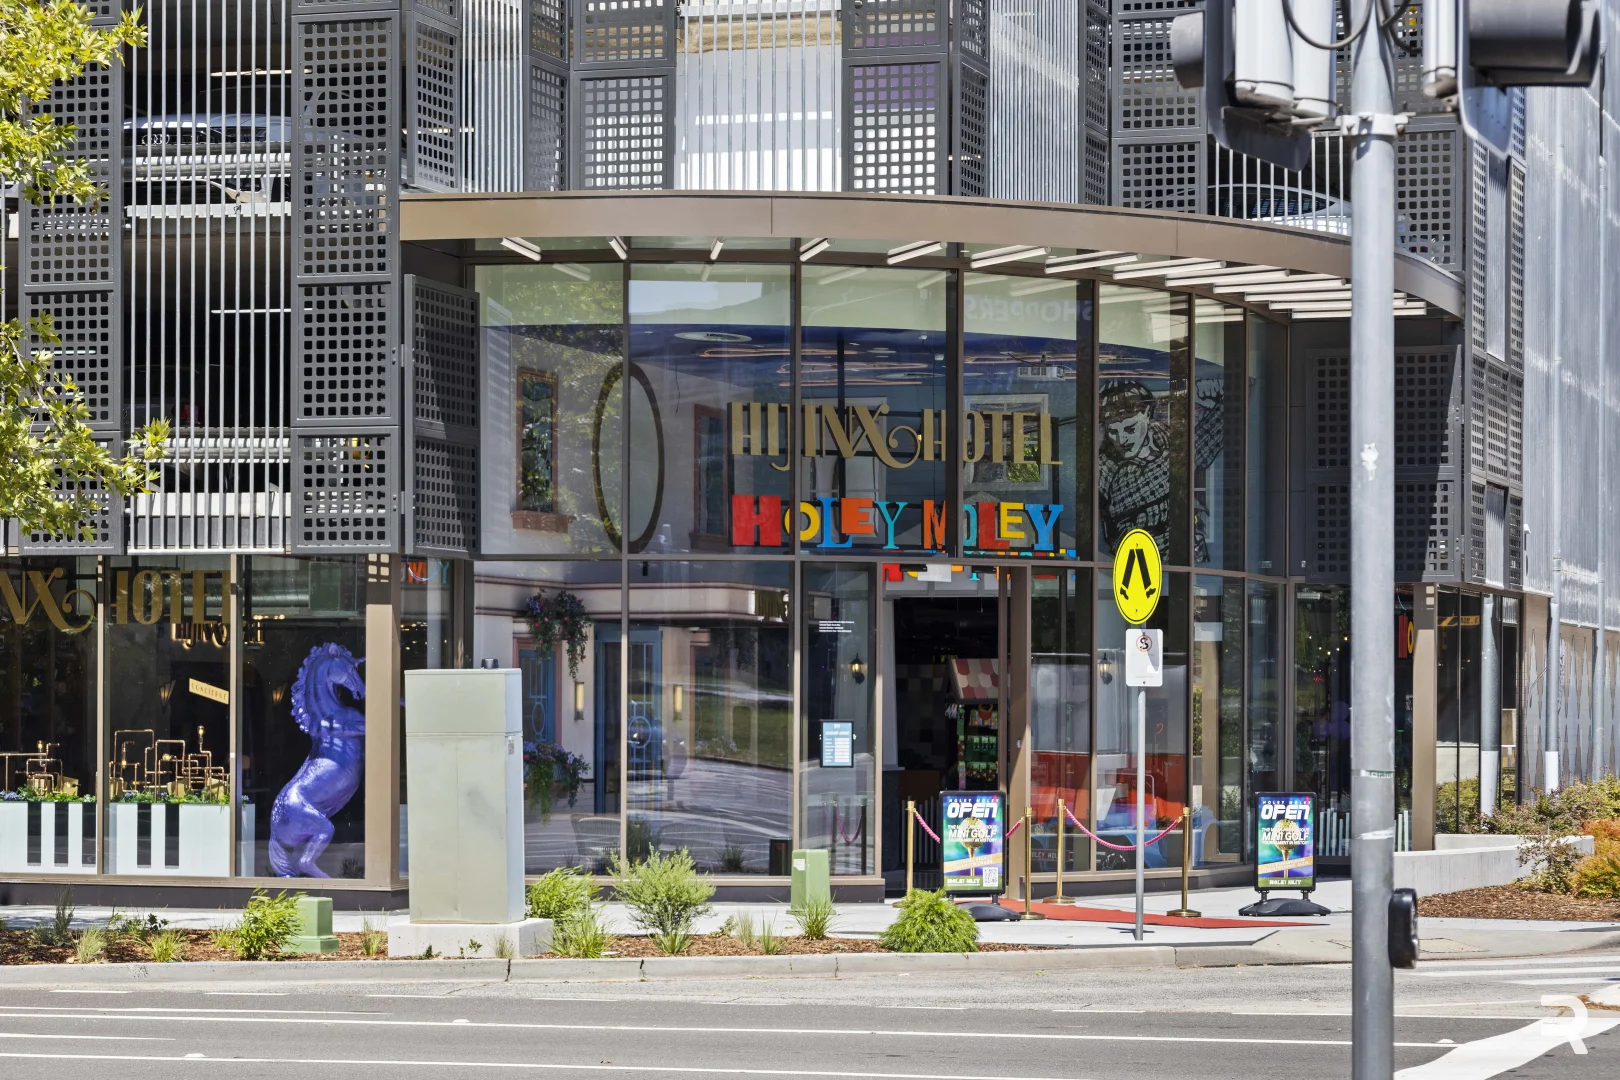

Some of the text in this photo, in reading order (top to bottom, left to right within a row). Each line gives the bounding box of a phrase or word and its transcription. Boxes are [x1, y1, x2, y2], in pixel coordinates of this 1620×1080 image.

[731, 402, 1064, 471] HIJINX HOTEL
[731, 495, 909, 550] HOLEY
[190, 682, 228, 701] CONCIERGE
[946, 802, 999, 819] OPEN
[1260, 804, 1311, 820] OPEN
[970, 829, 998, 838] GOLF
[1285, 832, 1310, 841] GOLF
